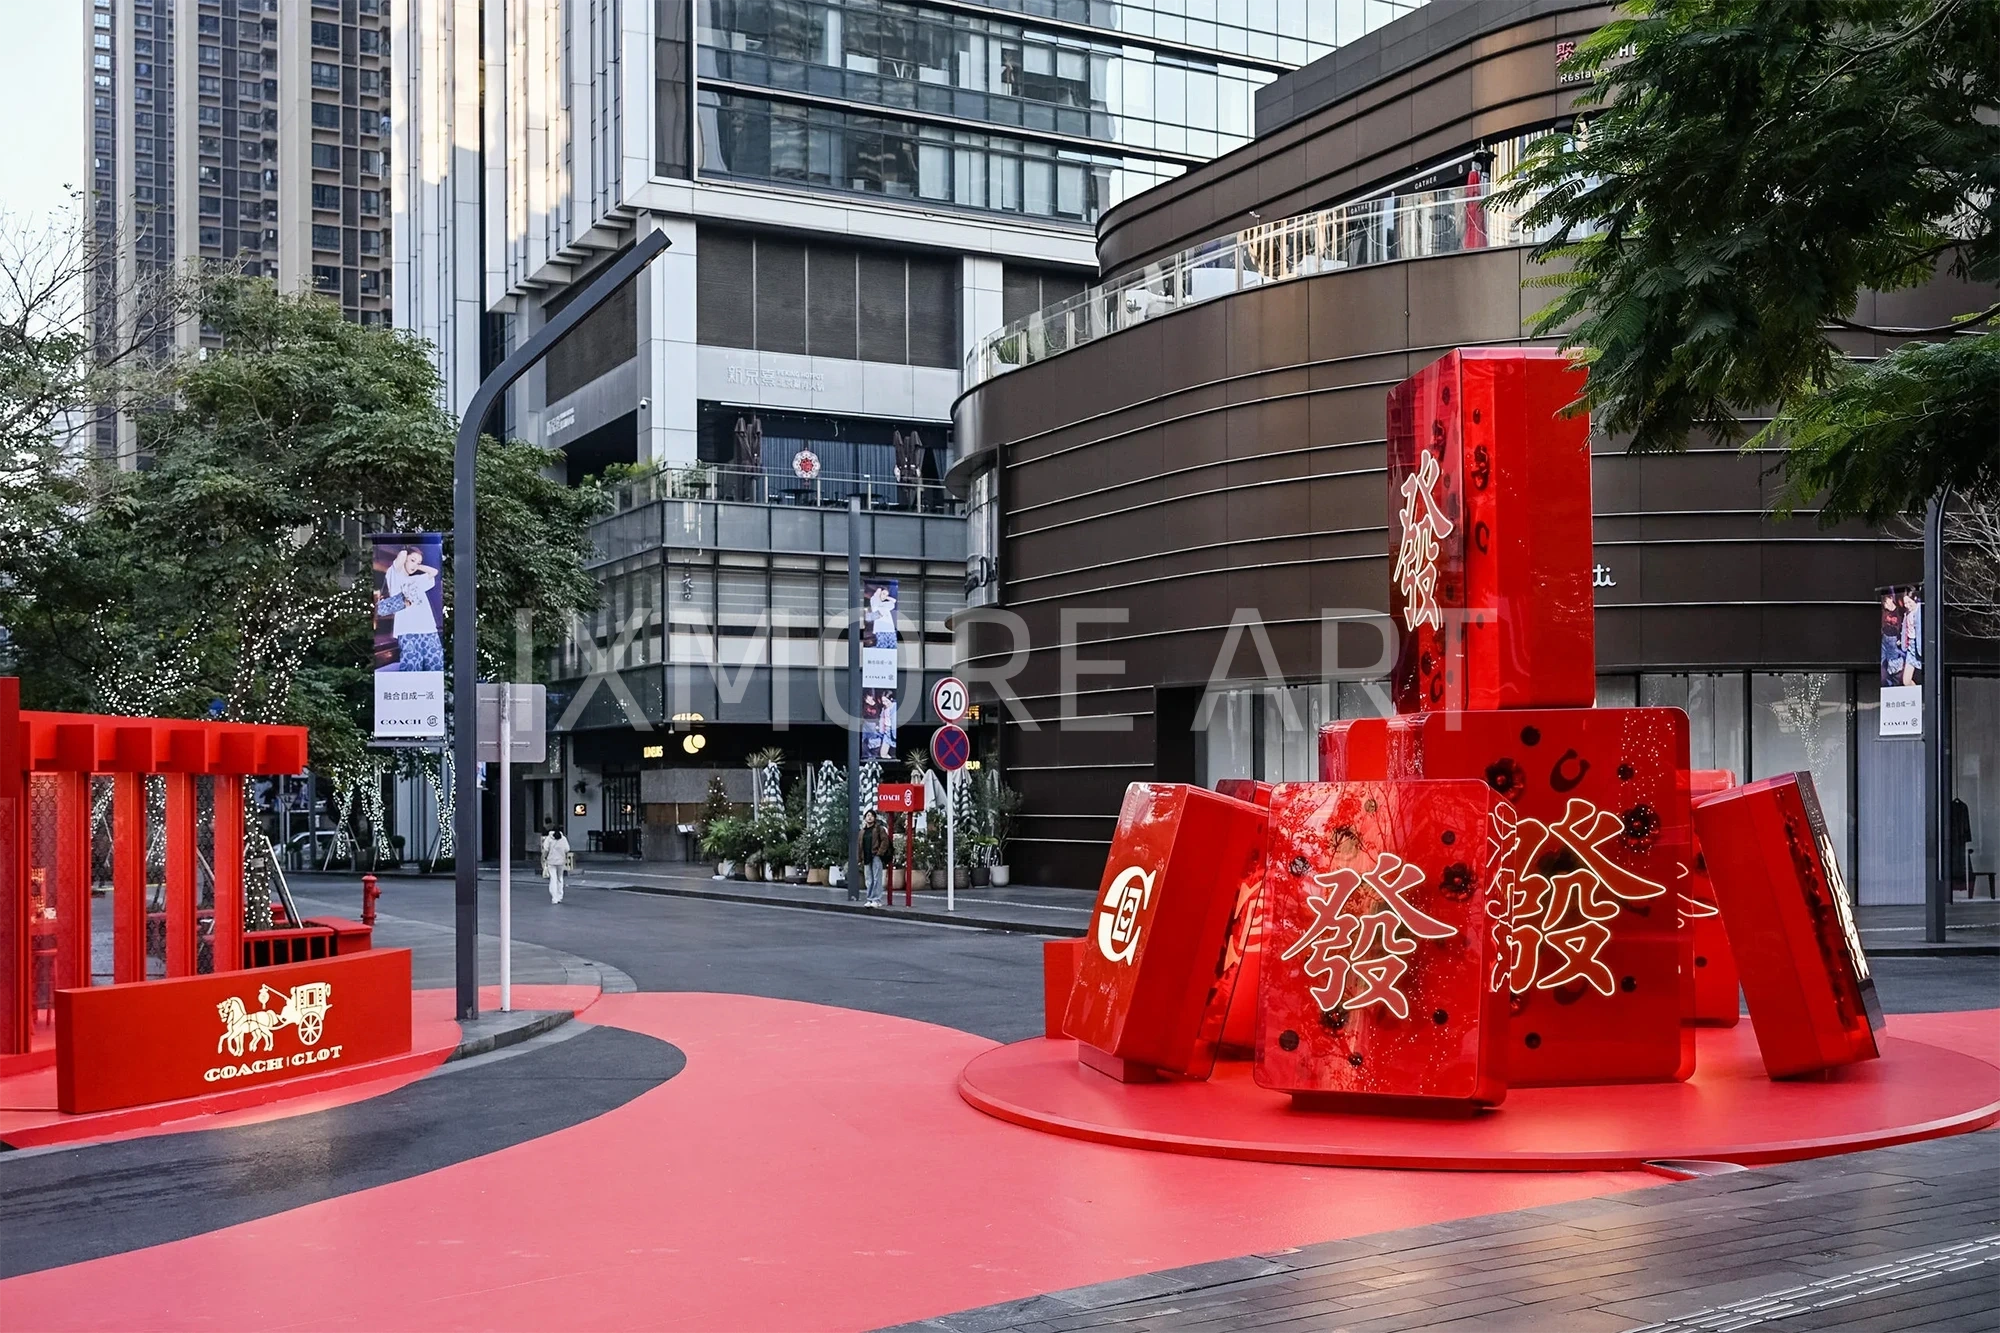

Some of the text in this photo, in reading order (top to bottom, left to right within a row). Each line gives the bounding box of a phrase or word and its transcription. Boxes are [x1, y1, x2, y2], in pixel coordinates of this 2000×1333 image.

[1593, 564, 1617, 586] ti
[384, 692, 434, 700] 融合自成一派
[941, 690, 963, 711] 20
[966, 760, 980, 770] EUR
[1281, 852, 1457, 1019] 發
[204, 1045, 343, 1082] COACH CLOT
